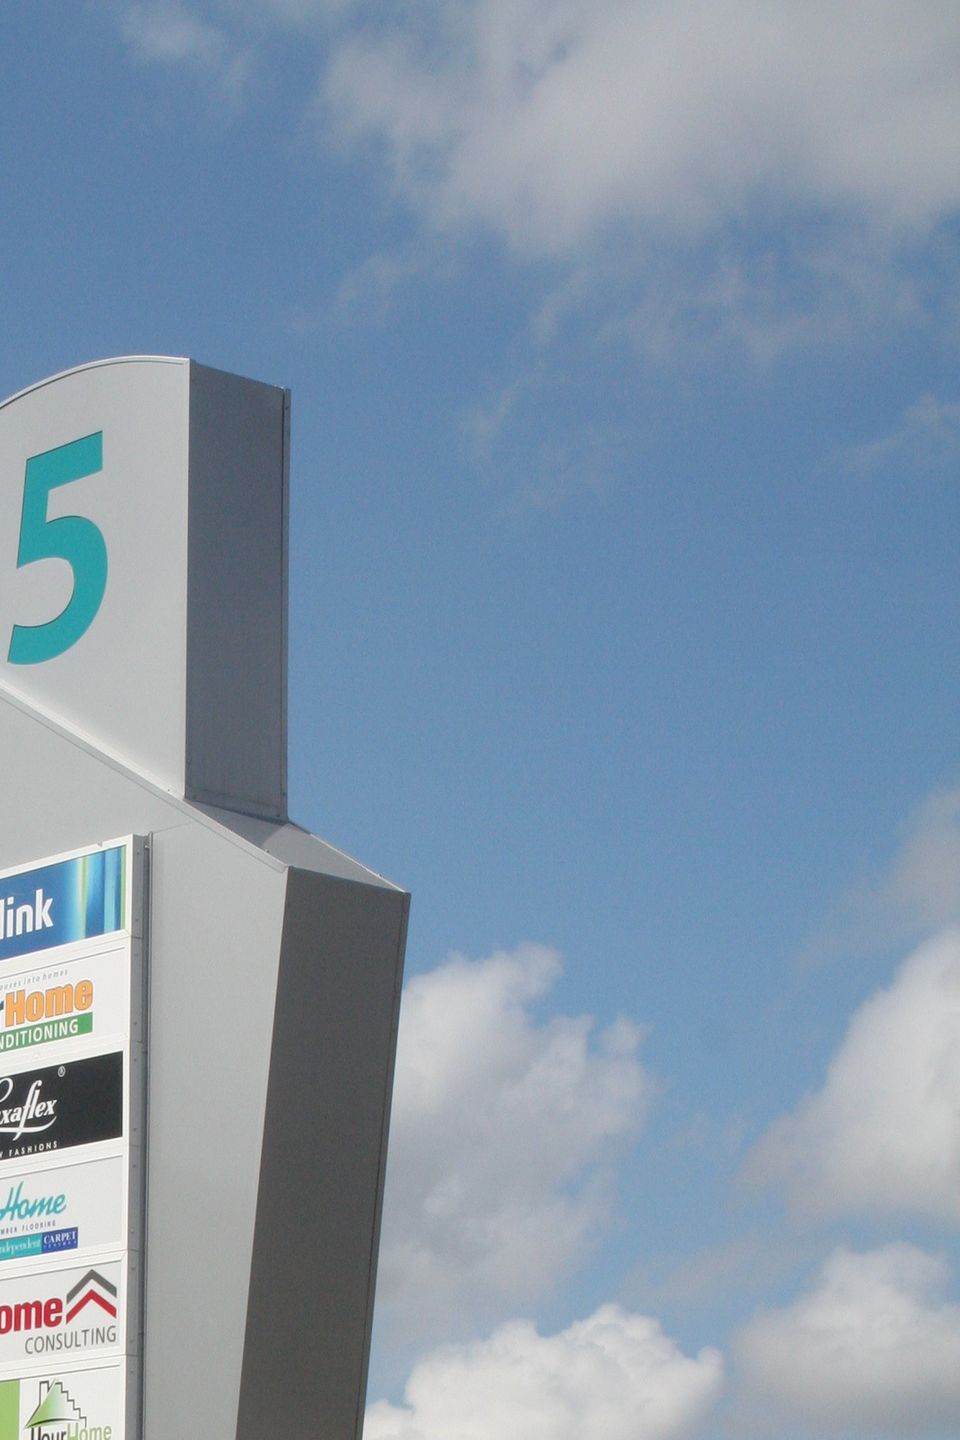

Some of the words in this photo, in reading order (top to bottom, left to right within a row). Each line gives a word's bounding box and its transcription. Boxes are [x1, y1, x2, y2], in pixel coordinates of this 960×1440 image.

[7, 430, 108, 665] 5
[8, 1140, 58, 1157] FASHIONS
[43, 1231, 77, 1245] CARPET
[25, 1325, 117, 1354] CONSULTING
